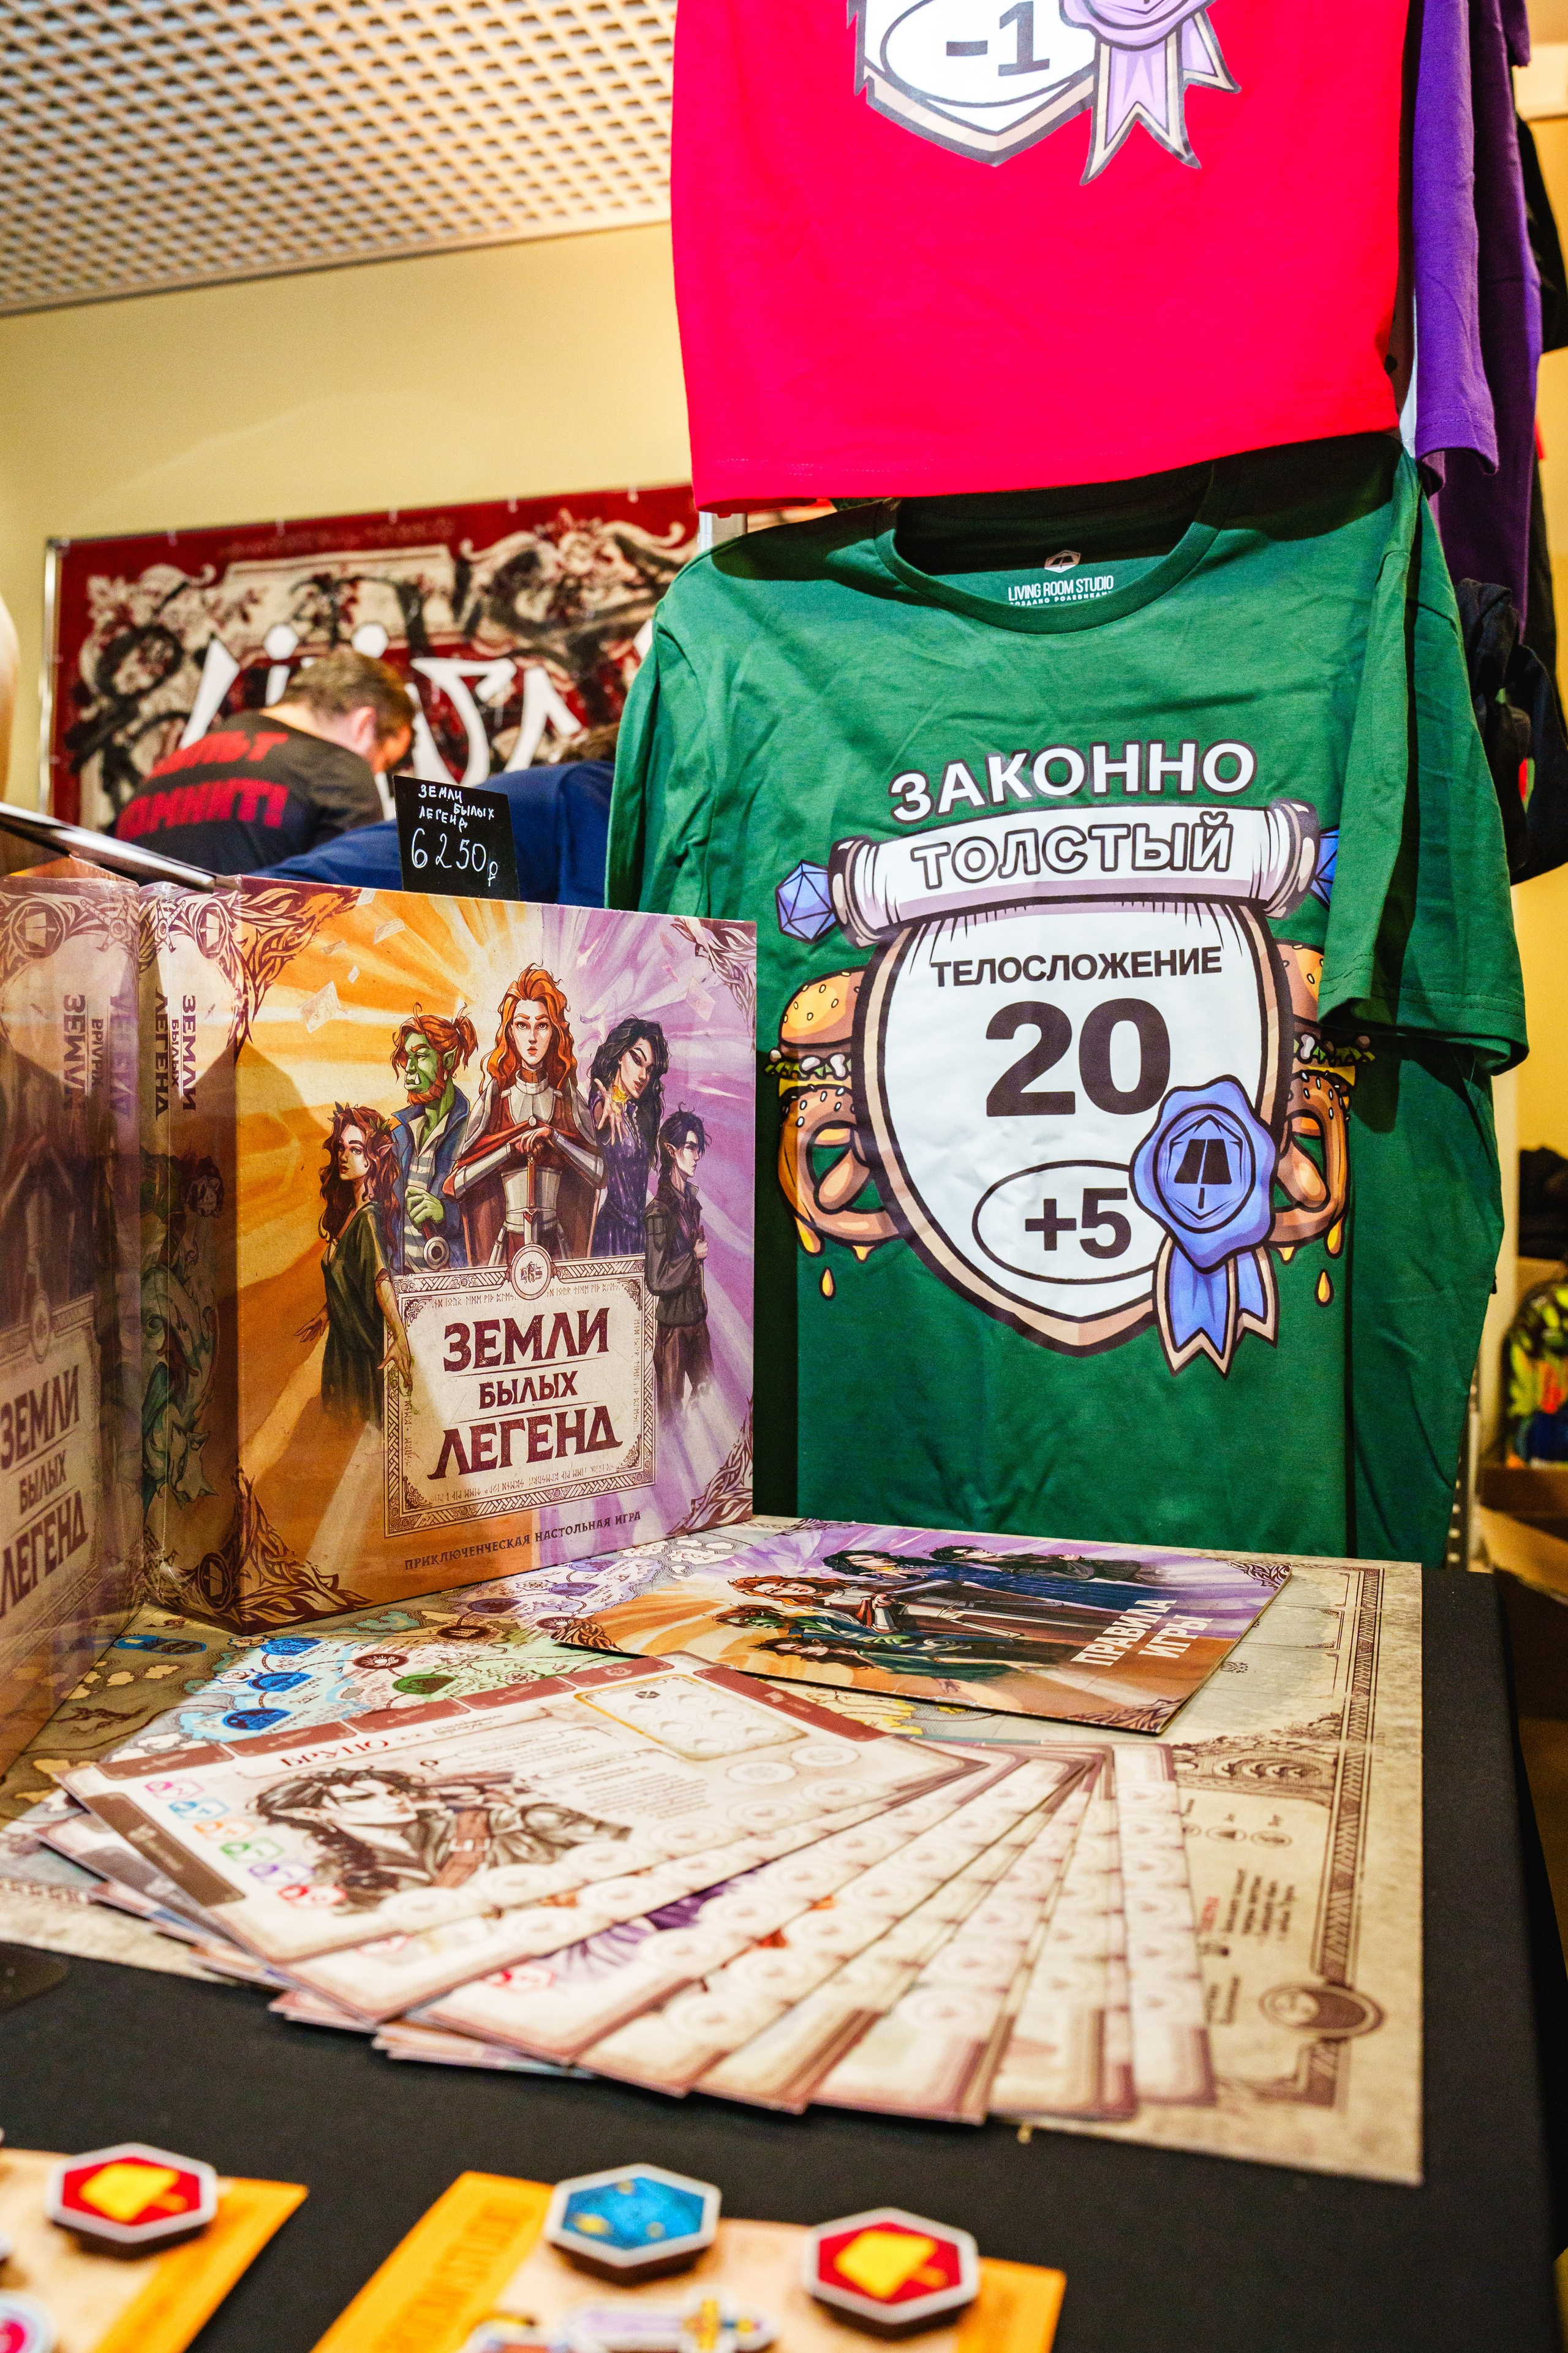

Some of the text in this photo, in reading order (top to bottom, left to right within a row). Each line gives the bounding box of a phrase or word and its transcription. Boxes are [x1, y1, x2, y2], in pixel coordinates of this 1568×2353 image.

[946, 1, 1050, 77] -1
[1008, 575, 1114, 602] LIVING ROOM STUDIO
[1054, 591, 1111, 602] РОЛЕВИКАМ
[454, 803, 494, 820] БЫЛЫХ
[888, 739, 1257, 823] ЗАКОННО
[911, 811, 1233, 889] ТОЛСТЫЙ
[930, 945, 1222, 988] ТЕЛОСЛОЖЕНИЕ
[155, 986, 168, 1121] ЛЕГЕНД
[183, 995, 196, 1112] ЗЕМЛИ
[985, 997, 1170, 1117] 20
[1025, 1187, 1131, 1259] +5
[443, 1307, 611, 1372] ЗЕМЛИ
[0, 1364, 80, 1470] ЗЕМЛИ
[478, 1370, 579, 1410] БЫЛЫХ
[427, 1405, 623, 1481] ЛЕГЕНД
[19, 1449, 67, 1515] БЫЛЫХ
[0, 1490, 89, 1620] ЛЕГЕНД
[404, 1511, 641, 1570] ПРИКЛЮЧЕНЧЕСКАЯ НАСТОЛЬНАЯ ИГРА
[1070, 1600, 1177, 1666] ПРАВИЛА
[1137, 1614, 1214, 1658] ИГРЫ
